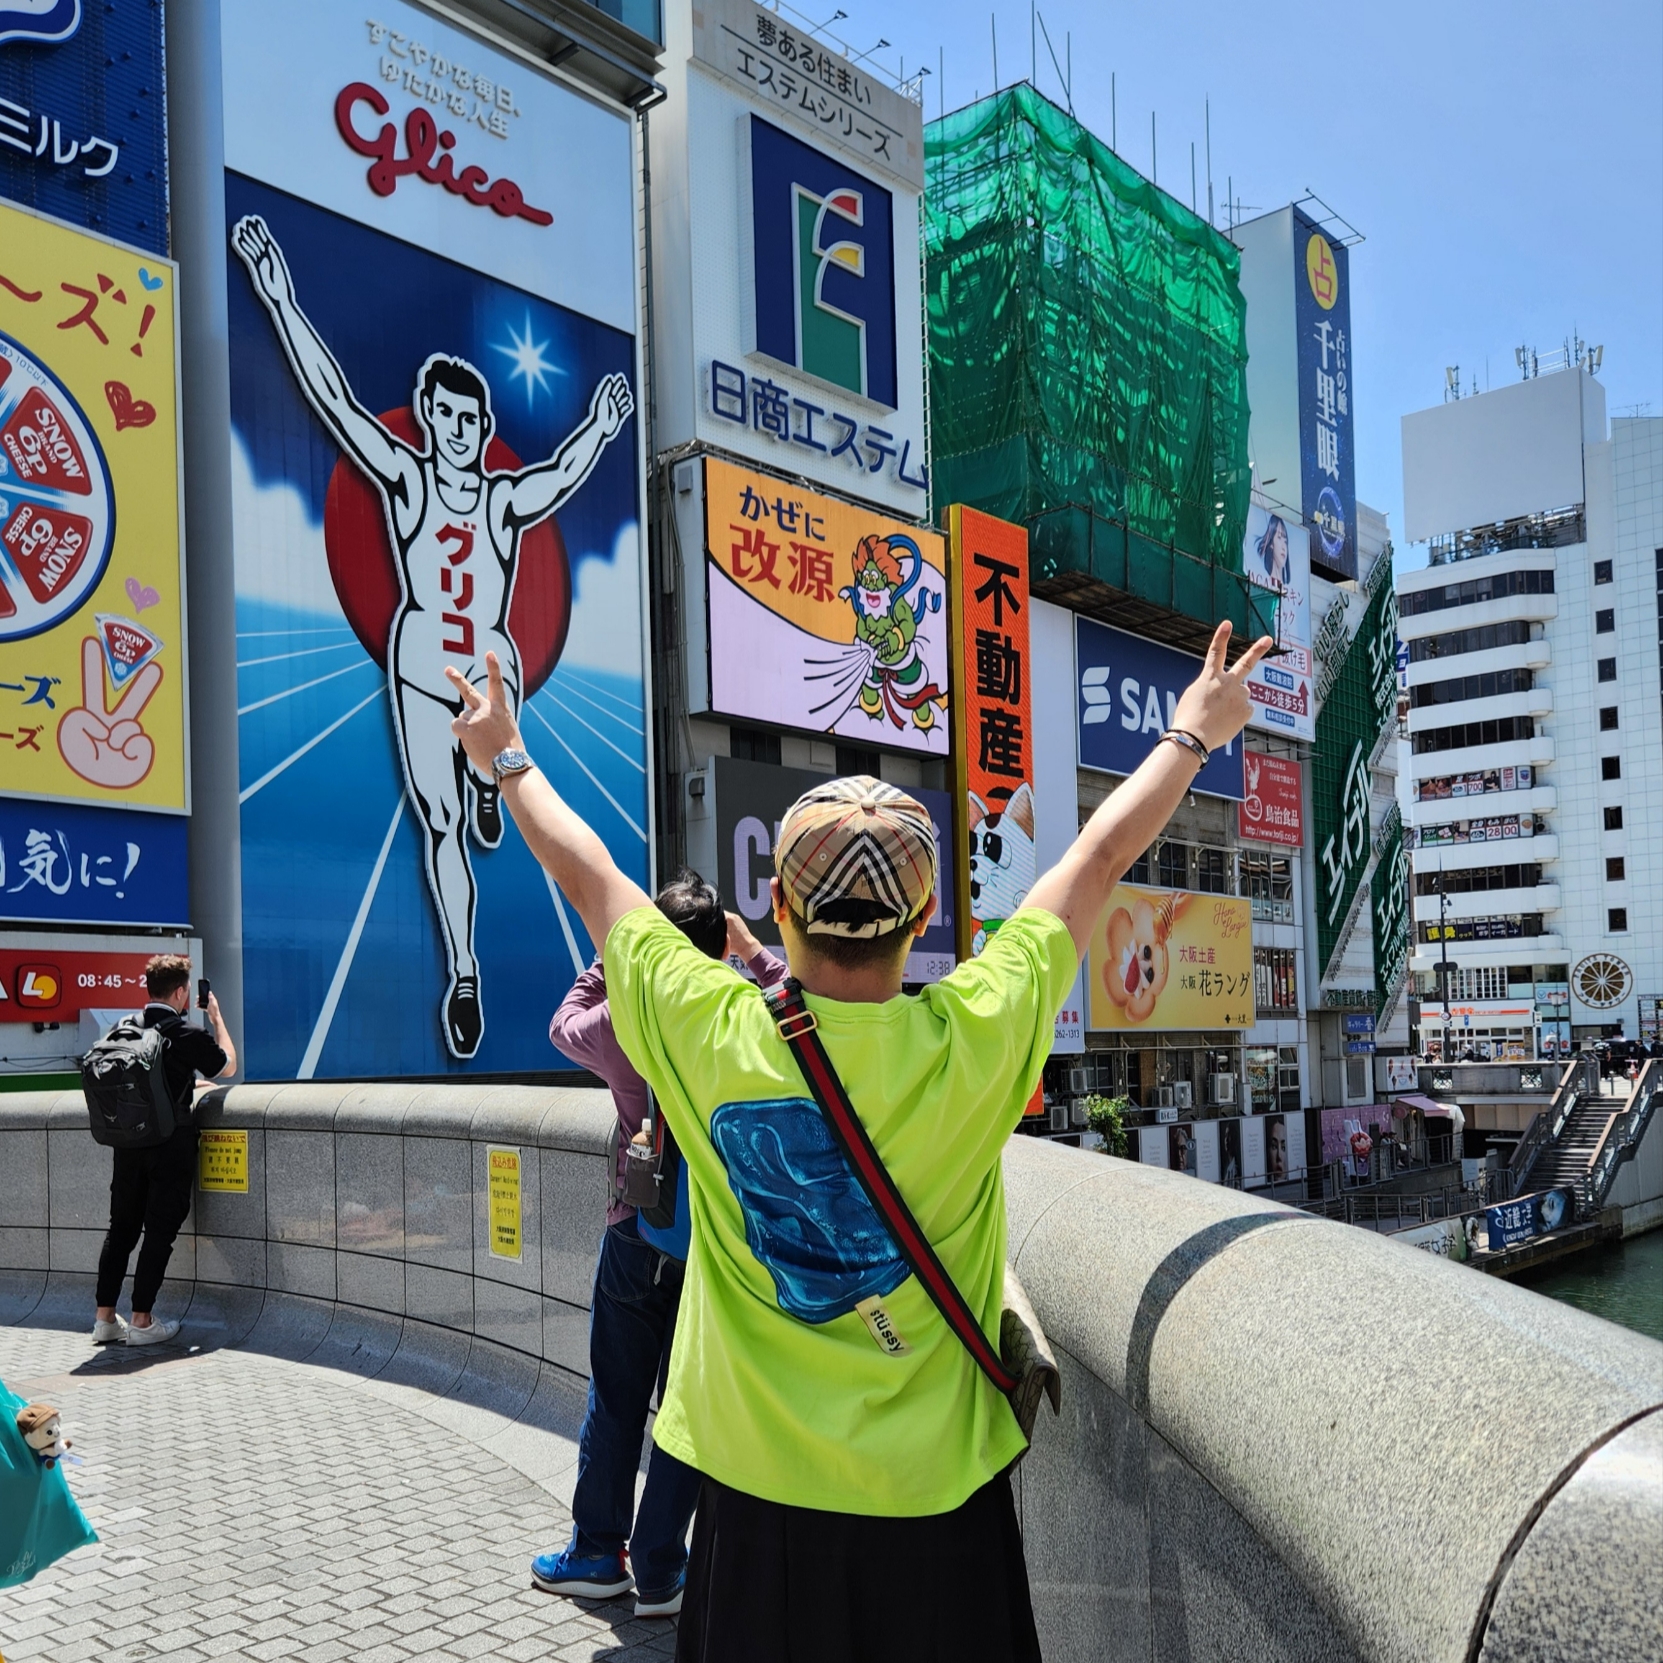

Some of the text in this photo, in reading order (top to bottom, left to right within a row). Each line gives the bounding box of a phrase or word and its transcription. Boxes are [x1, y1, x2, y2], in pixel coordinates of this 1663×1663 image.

[366, 18, 521, 117] すこやかな毎日、
[755, 13, 872, 106] 夢ある住まい
[380, 55, 508, 140] ゆたかな人生
[736, 47, 891, 161] エステムシリーズ
[335, 82, 554, 226] Glico
[1313, 238, 1334, 303] 占
[711, 359, 930, 491] 日商エステム
[1313, 320, 1340, 483] 千里眼
[4, 433, 32, 478] CHEESE
[19, 425, 48, 475] 6P
[35, 406, 84, 479] SNOW
[38, 431, 57, 464] BRAND
[5, 507, 33, 544] CHEESE
[20, 518, 54, 557] 6P
[739, 485, 826, 542] かぜに
[39, 527, 83, 592] SNOW
[435, 521, 476, 656] グリコ
[729, 523, 836, 604] 改源
[112, 627, 146, 648] SNOW
[973, 551, 1027, 798] 不動産
[0, 829, 140, 899] 気に!
[926, 960, 950, 976] 12:38
[1179, 945, 1216, 965] 大阪土産
[1180, 974, 1197, 990] 大阪
[1198, 969, 1250, 997] 花ラング
[870, 1309, 905, 1352] stüssy
